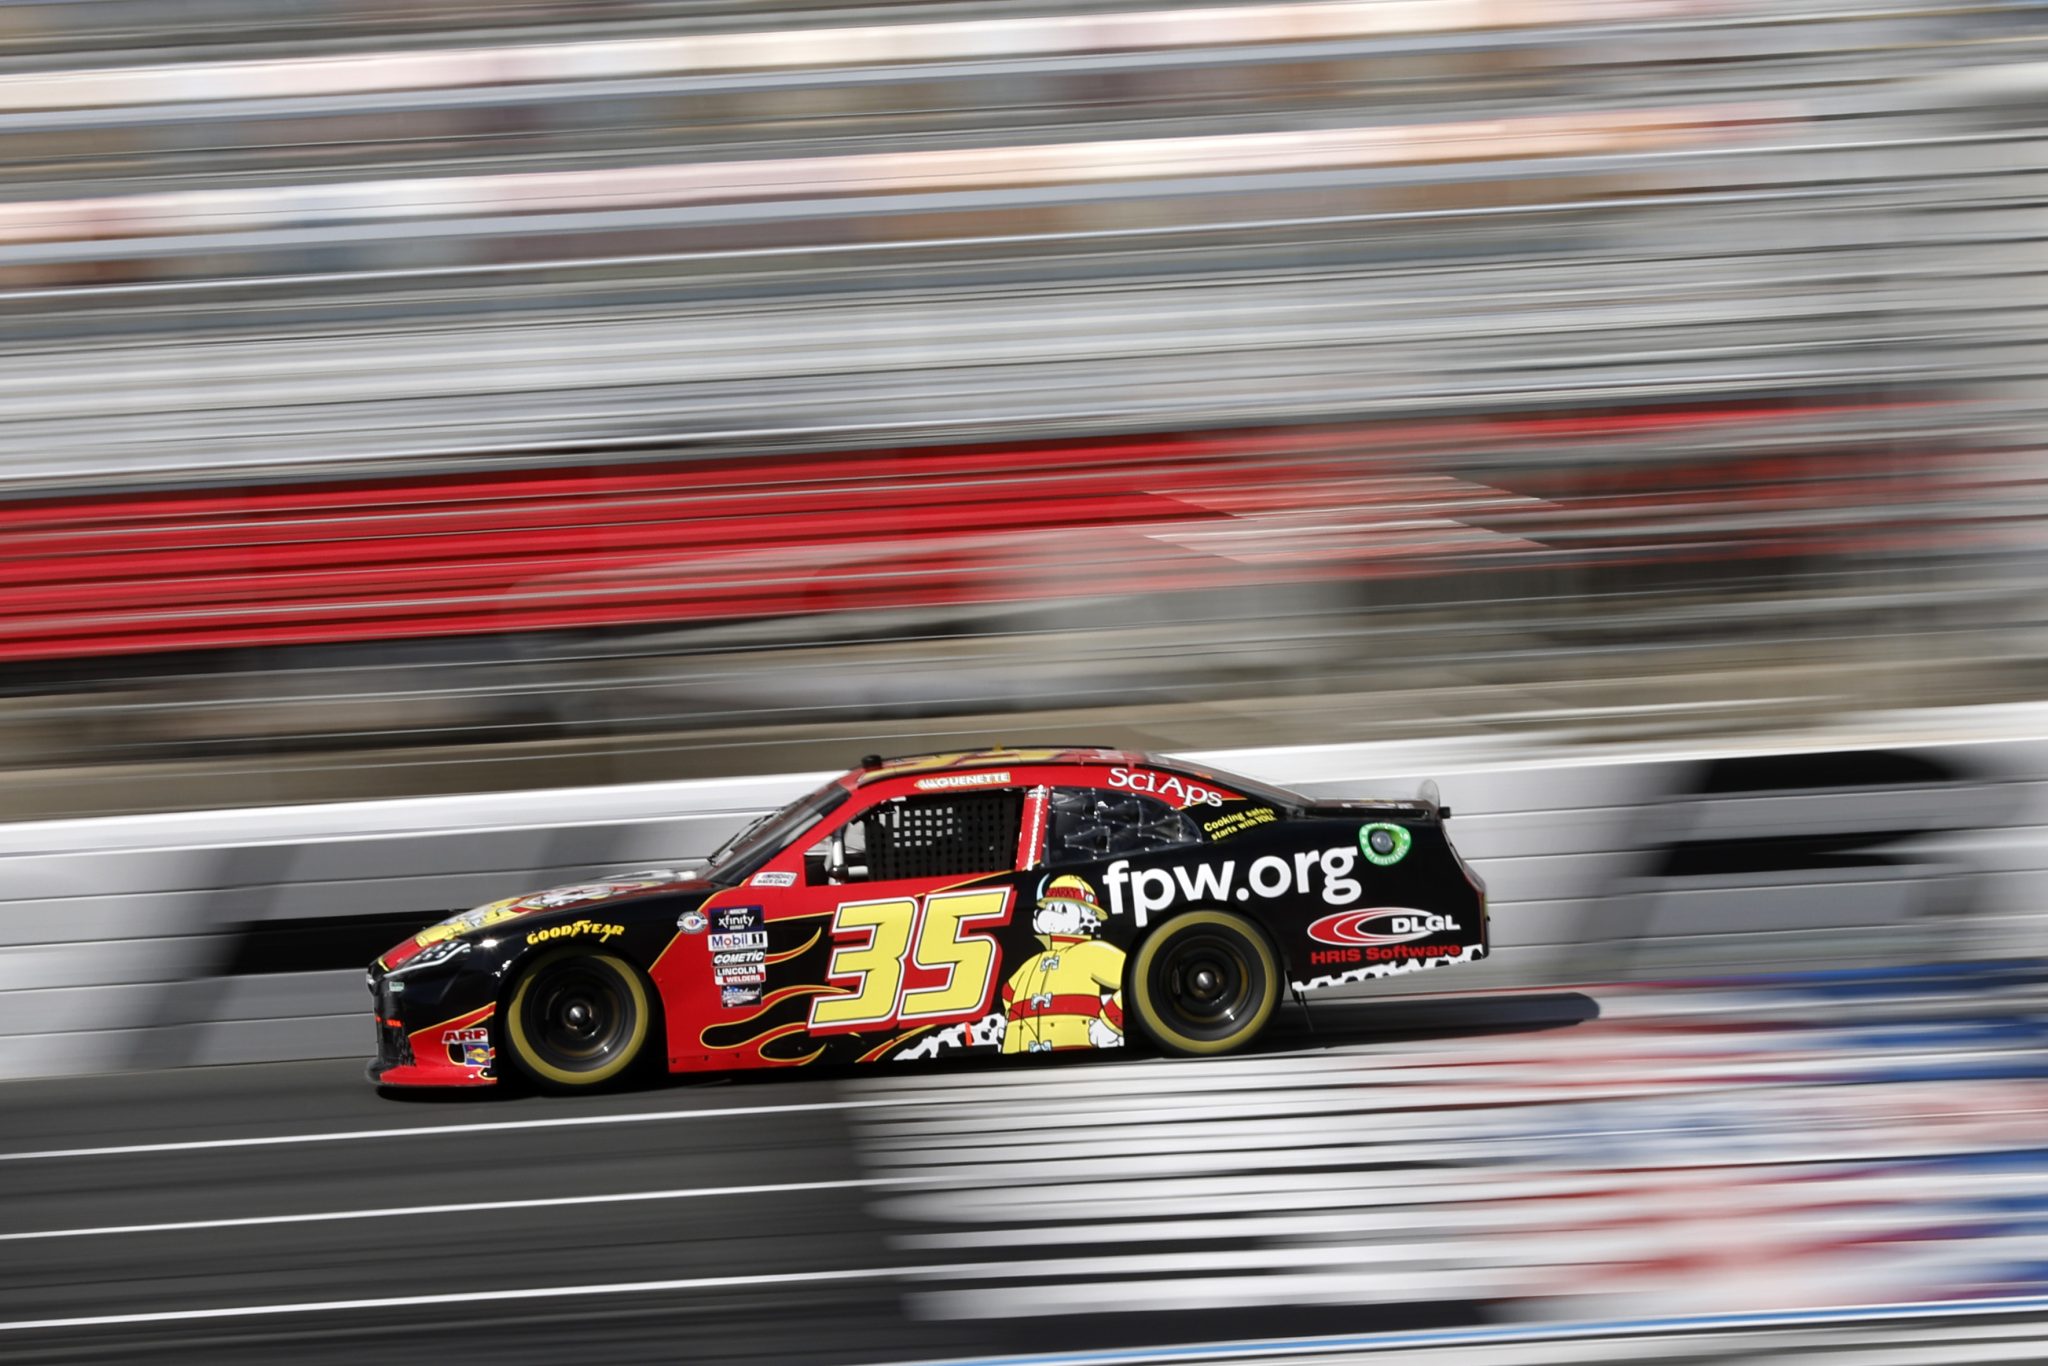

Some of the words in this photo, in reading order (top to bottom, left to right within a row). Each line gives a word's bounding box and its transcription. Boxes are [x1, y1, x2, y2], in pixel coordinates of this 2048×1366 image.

[1108, 767, 1223, 808] SciAps
[1203, 812, 1246, 832] Cooking
[1211, 825, 1239, 841] starts
[1237, 818, 1259, 830] with
[1102, 846, 1362, 928] fpw.org
[718, 914, 755, 929] xfinity
[1391, 914, 1461, 934] DLGL
[526, 919, 625, 945] GOODYEAR
[712, 934, 748, 946] Mobil
[752, 933, 763, 945] 1
[807, 885, 1016, 1036] 35
[1311, 948, 1361, 965] HRIS
[1366, 944, 1463, 962] Software
[716, 966, 757, 977] LINCOLN
[726, 974, 761, 983] WELDERS
[443, 1028, 487, 1043] ARP
